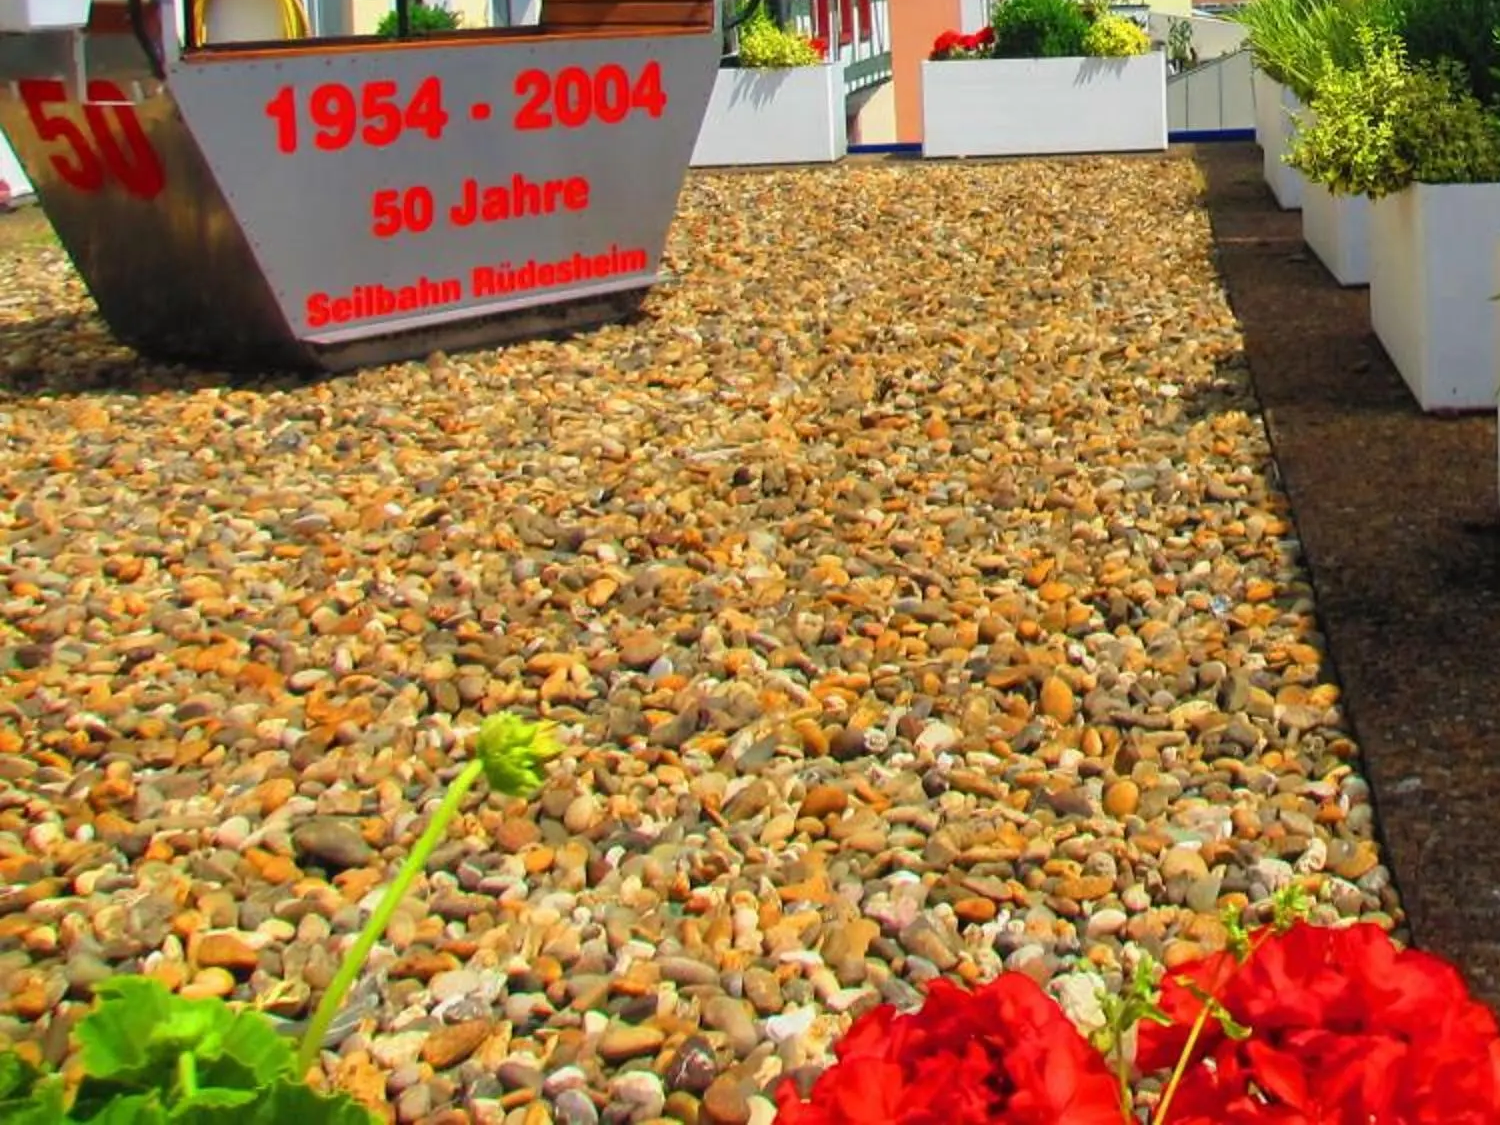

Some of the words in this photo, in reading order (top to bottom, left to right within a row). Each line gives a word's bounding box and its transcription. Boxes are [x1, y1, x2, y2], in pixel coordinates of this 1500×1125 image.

[16, 77, 168, 202] 50
[265, 77, 450, 155] 1954
[513, 61, 669, 132] 2004
[372, 187, 436, 240] 50
[449, 174, 592, 228] Jahre
[306, 278, 465, 330] Seilbahn
[470, 246, 650, 299] Rüdesheim
